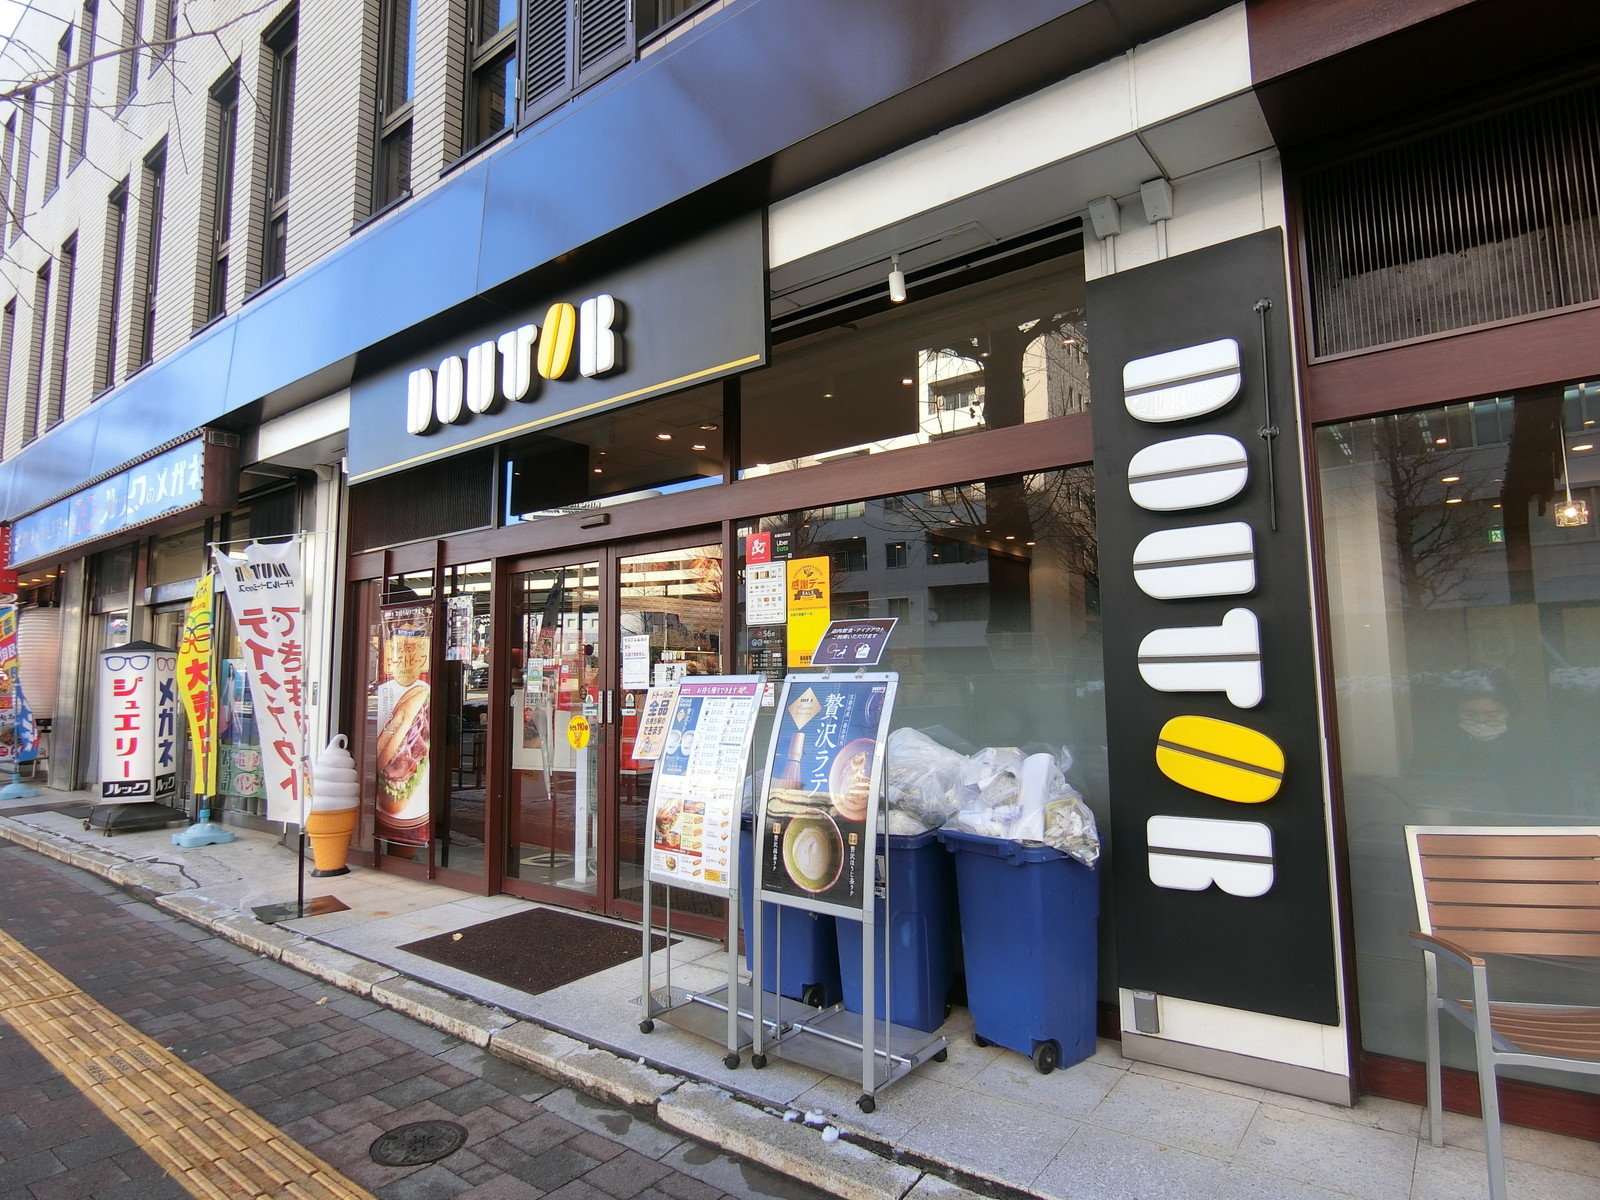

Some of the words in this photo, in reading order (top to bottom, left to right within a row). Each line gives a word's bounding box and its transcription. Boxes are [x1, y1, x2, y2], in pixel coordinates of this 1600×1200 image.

[407, 293, 617, 435] DOUTOR
[1122, 337, 1285, 898] DOUTOR
[113, 676, 144, 778] ジュエリー
[158, 677, 175, 768] メガネ
[643, 725, 664, 736] できます
[648, 699, 671, 717] 全品
[807, 692, 846, 798] 贅沢ラテ
[104, 782, 149, 796] ルック
